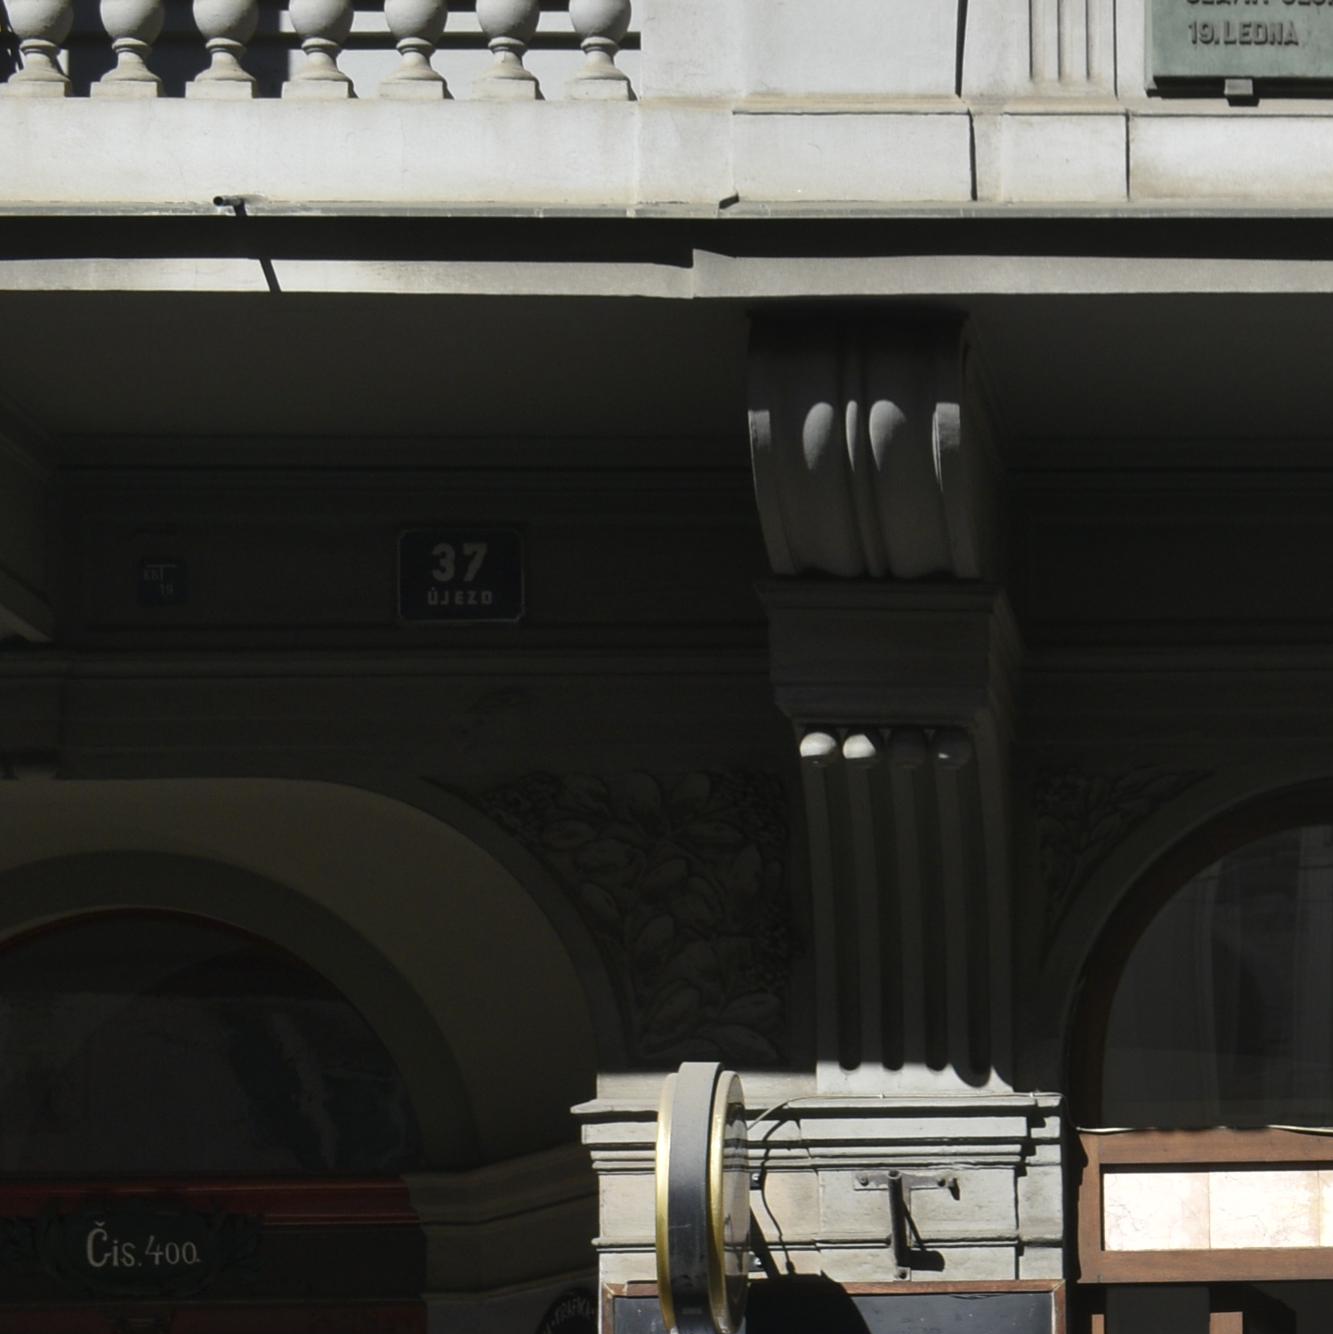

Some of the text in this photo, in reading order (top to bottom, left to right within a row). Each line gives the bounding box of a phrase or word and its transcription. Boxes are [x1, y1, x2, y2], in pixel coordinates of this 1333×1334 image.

[1188, 22, 1220, 45] 19.
[1223, 21, 1300, 46] LEDNA
[431, 542, 489, 582] 37
[86, 1221, 143, 1268] Čis.
